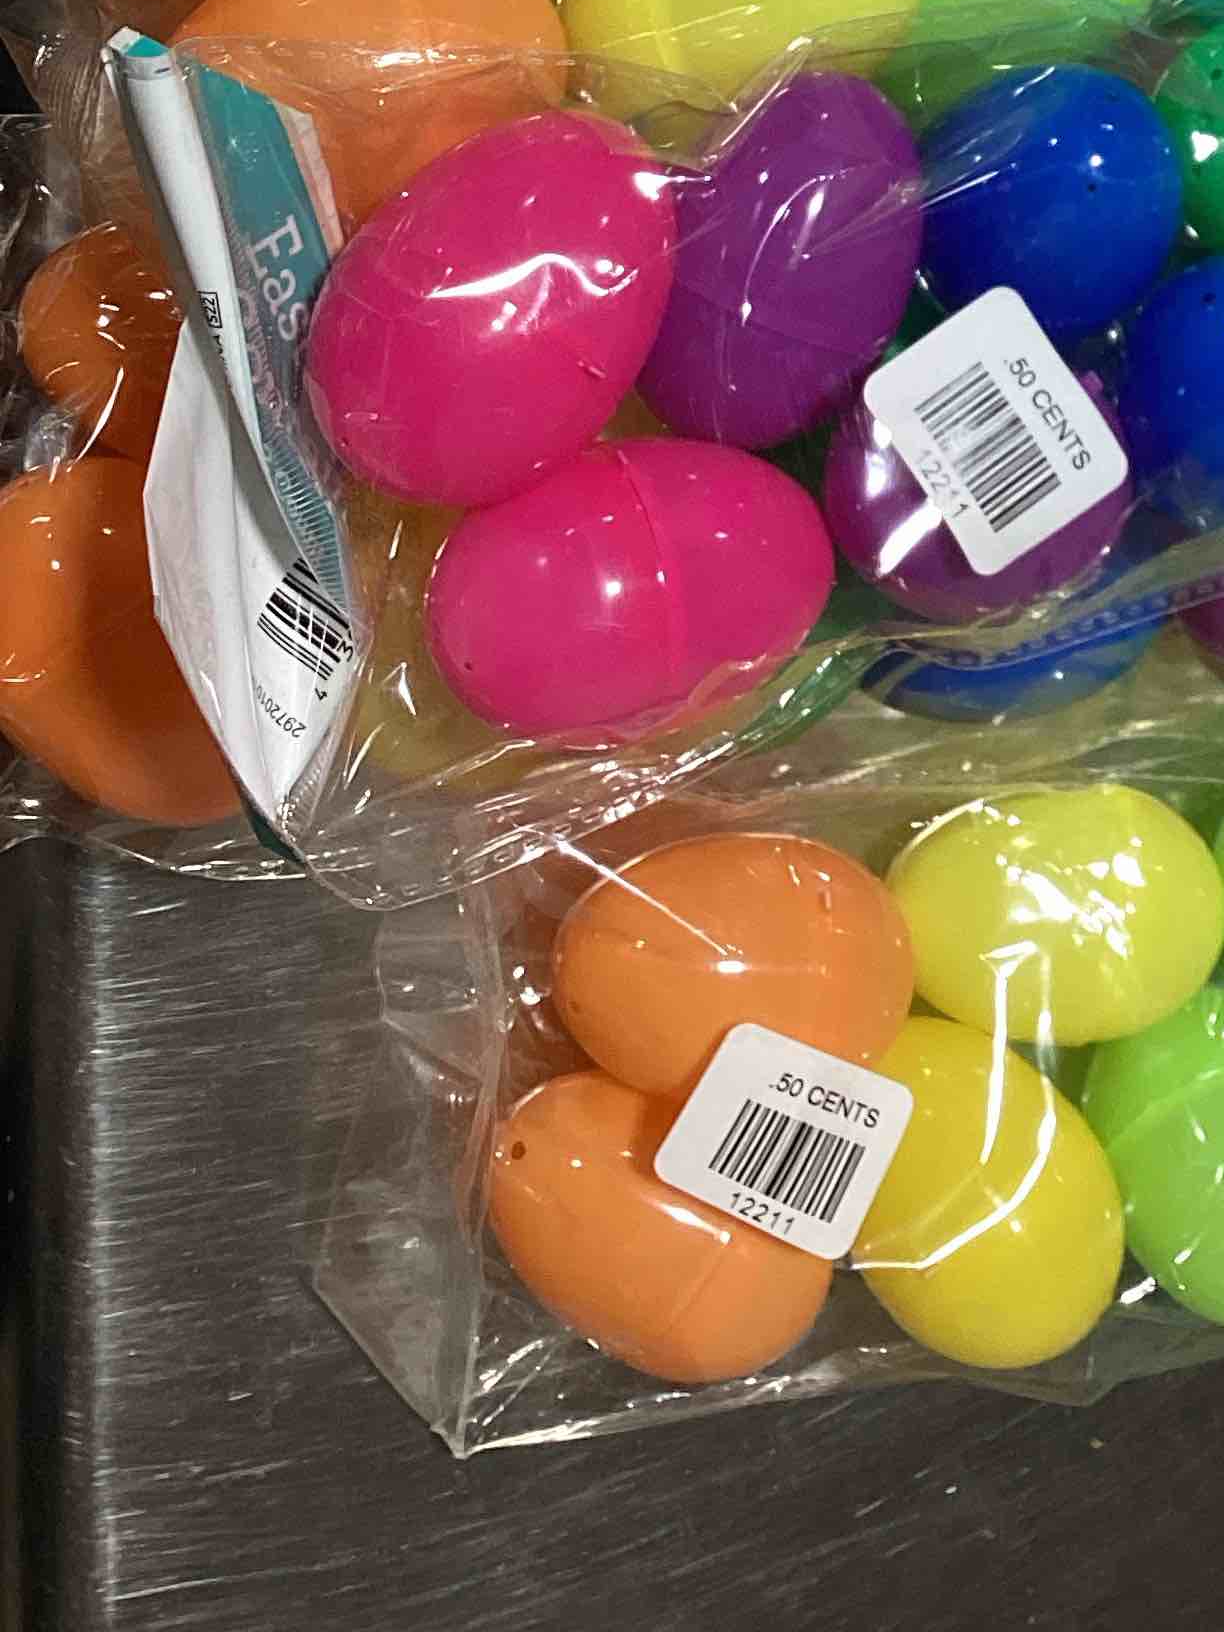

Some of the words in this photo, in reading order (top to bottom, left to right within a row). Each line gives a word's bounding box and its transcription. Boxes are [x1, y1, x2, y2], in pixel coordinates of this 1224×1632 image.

[1031, 388, 1092, 471] CENTS
[768, 1072, 804, 1098] .50
[807, 1085, 881, 1129] CENTS
[730, 1192, 795, 1236] 12211
